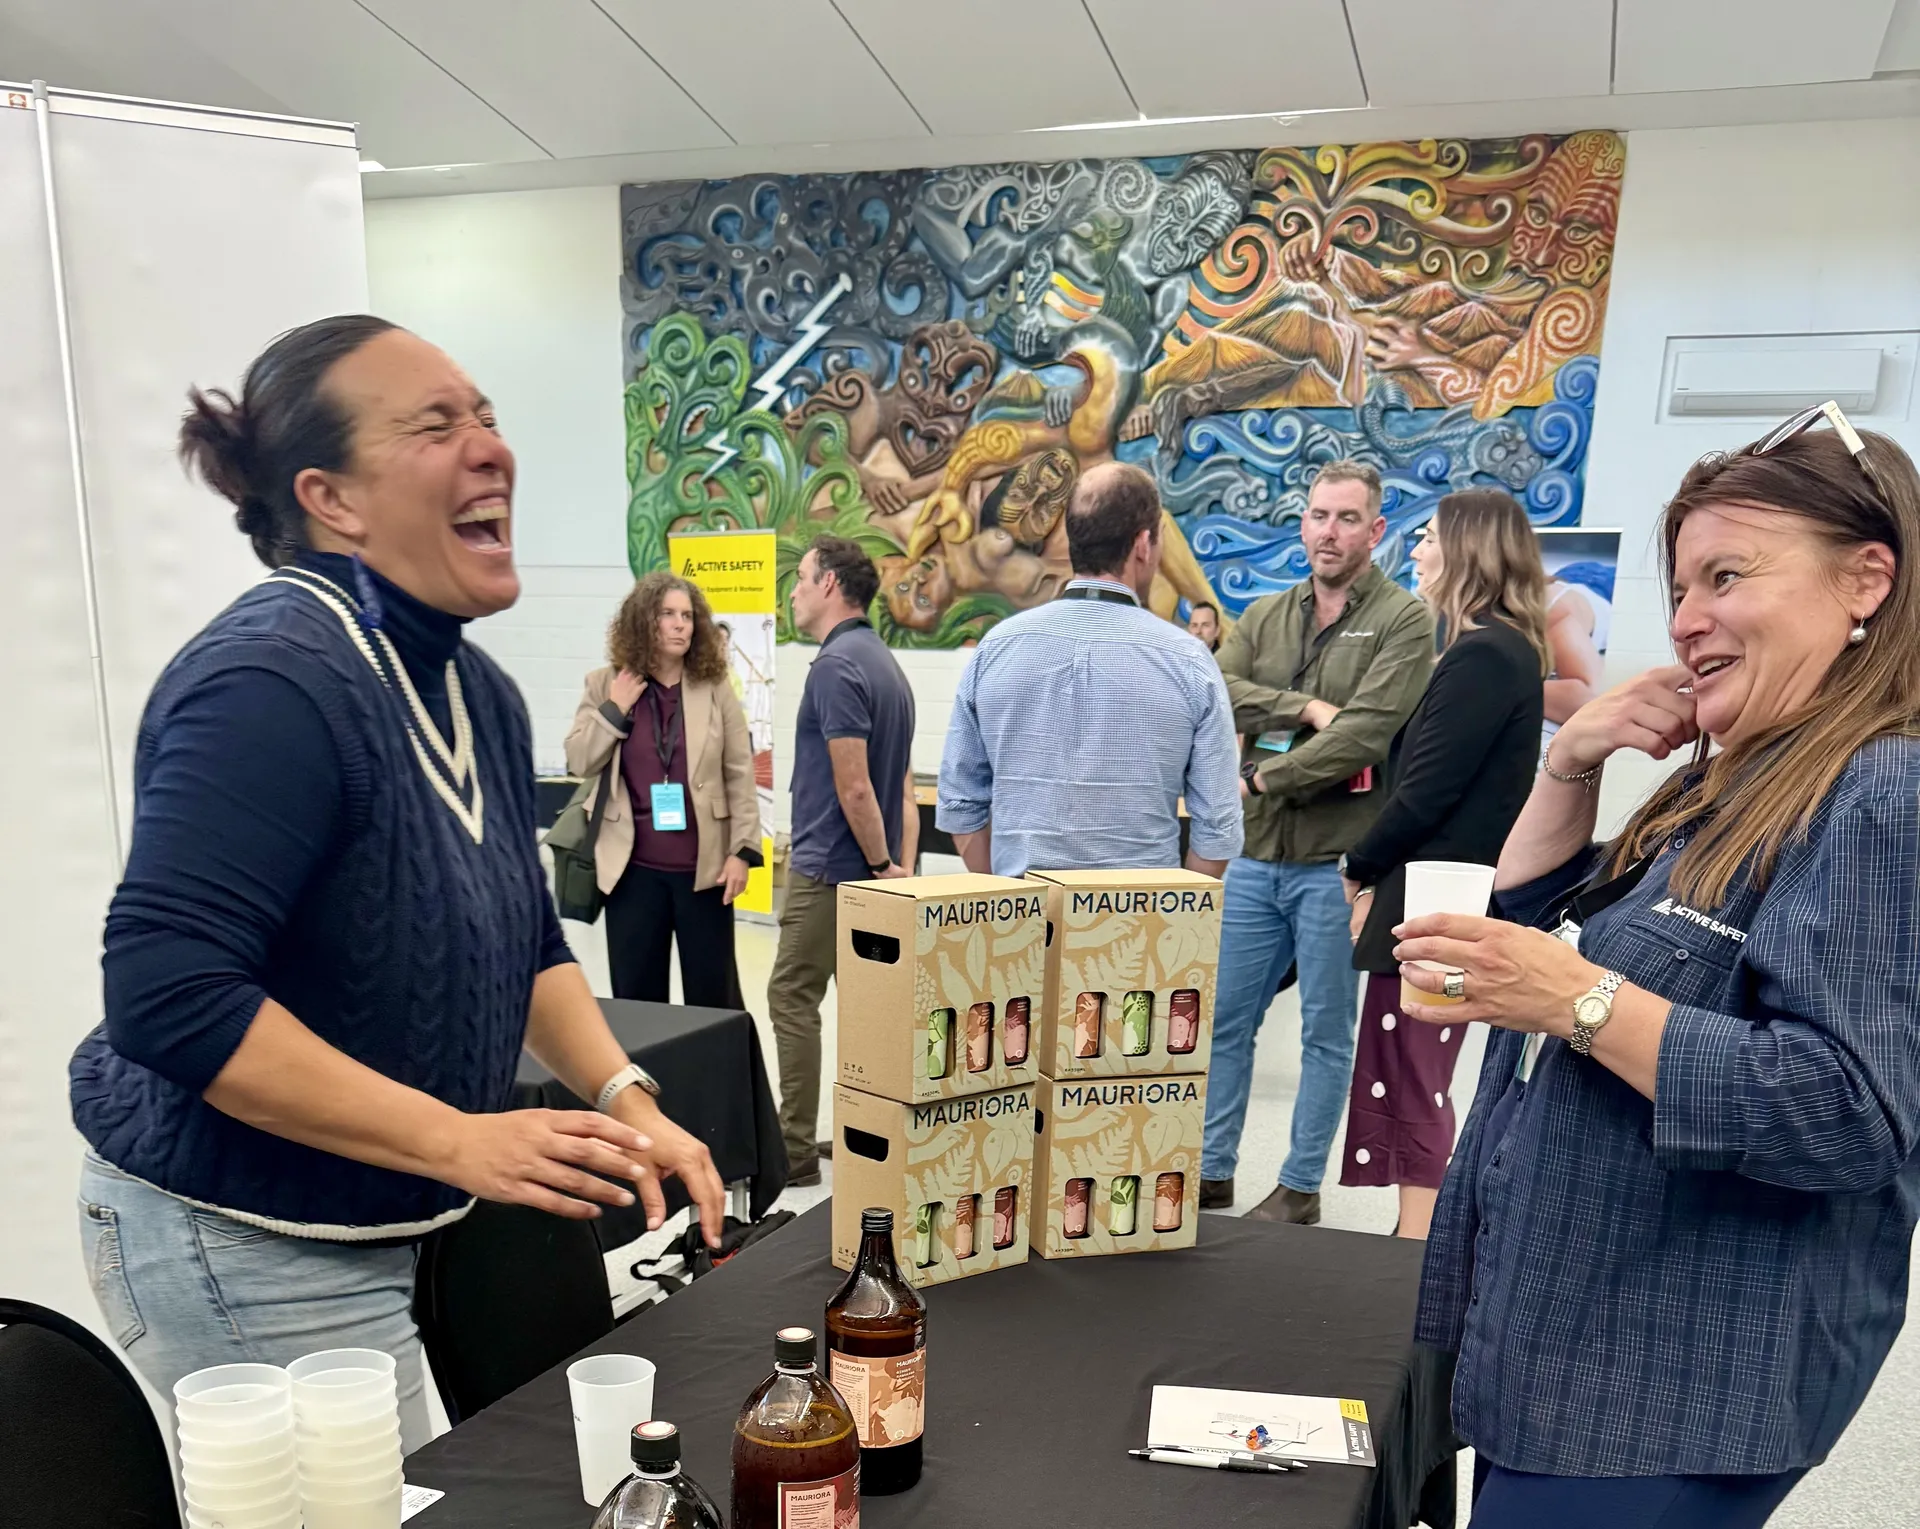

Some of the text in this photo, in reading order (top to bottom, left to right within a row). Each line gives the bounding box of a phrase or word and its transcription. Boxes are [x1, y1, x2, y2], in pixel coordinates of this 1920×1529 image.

[697, 560, 764, 572] ACTIVE SAFETY
[925, 896, 1042, 928] MAURIORA
[1072, 891, 1214, 913] MAURIORA
[1671, 904, 1748, 943] ACTIVE SAFET
[1061, 1082, 1198, 1107] MAURIORA
[913, 1091, 1029, 1130] MAURIORA
